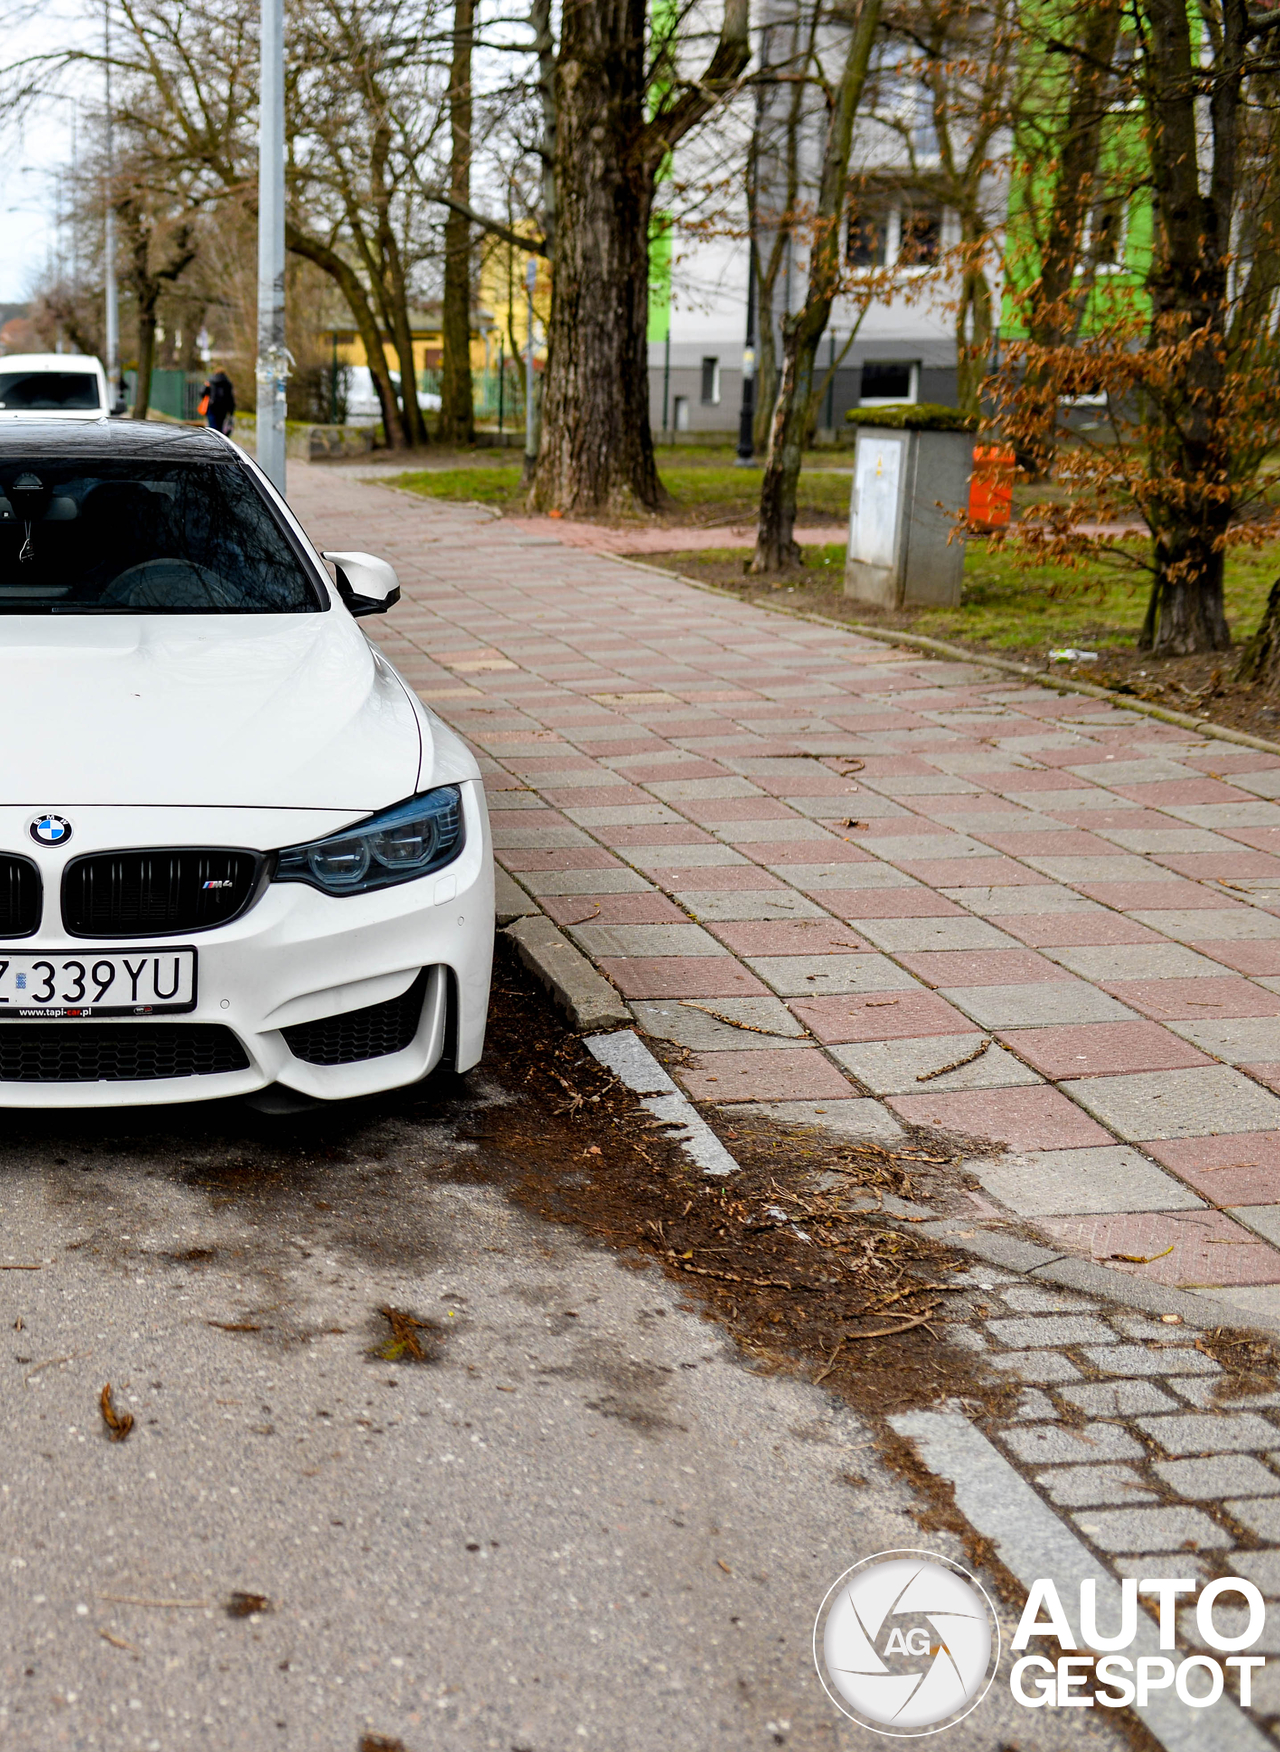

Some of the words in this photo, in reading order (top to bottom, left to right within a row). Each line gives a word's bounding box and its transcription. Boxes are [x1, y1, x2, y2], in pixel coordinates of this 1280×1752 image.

[33, 814, 69, 825] BMW
[31, 957, 180, 1003] 339YU
[19, 1007, 92, 1017] www.tapi-car.pl
